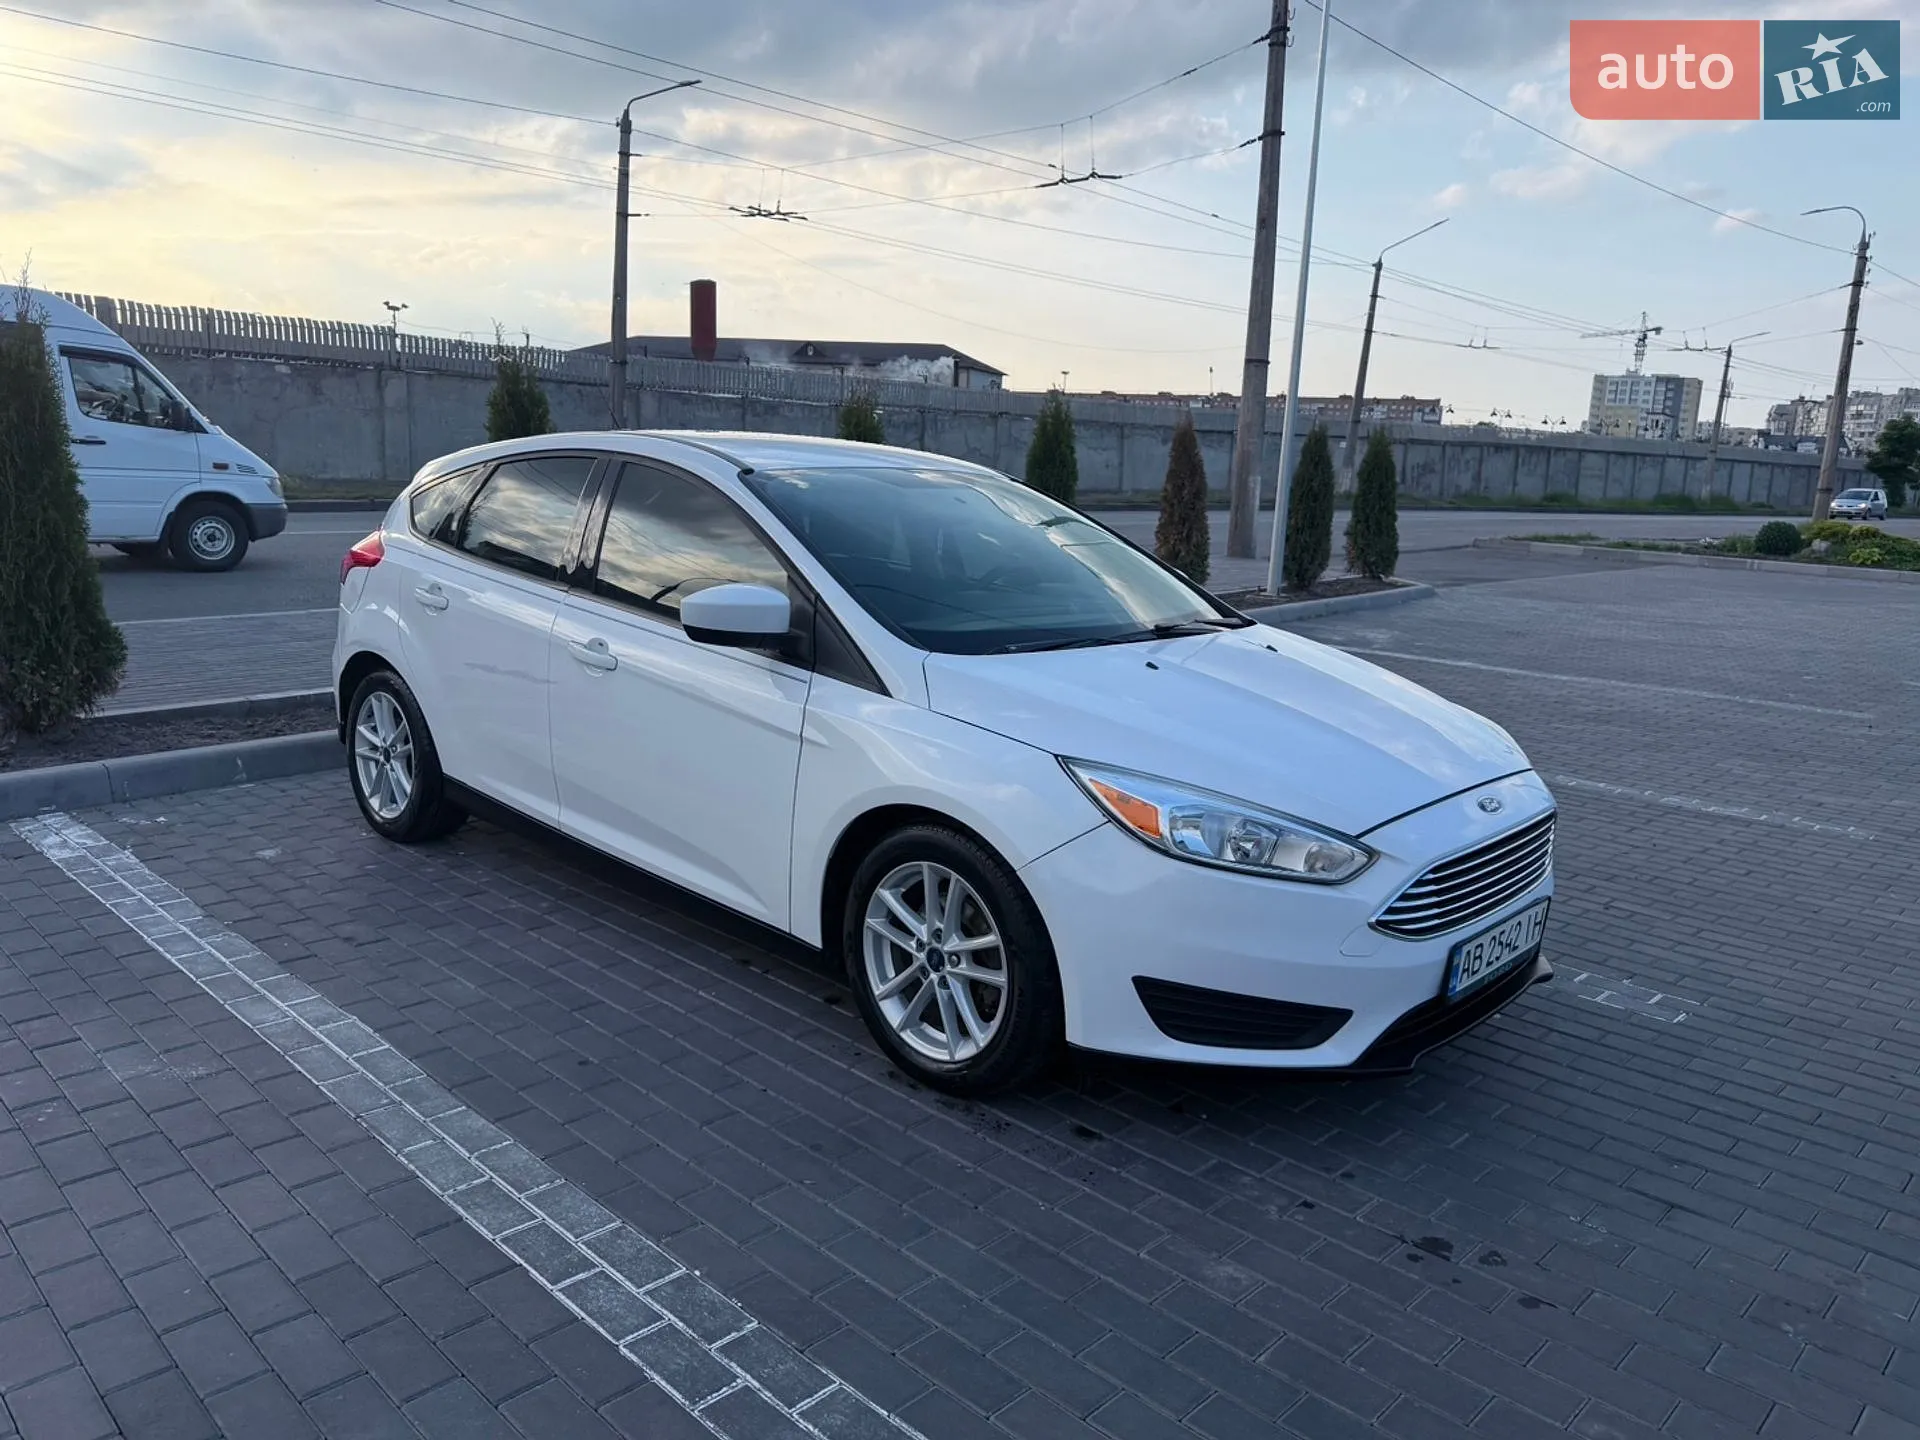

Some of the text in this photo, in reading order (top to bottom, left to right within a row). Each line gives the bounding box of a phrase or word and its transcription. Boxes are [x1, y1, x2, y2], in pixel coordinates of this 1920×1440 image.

[1459, 908, 1545, 984] AB 2542 IH
